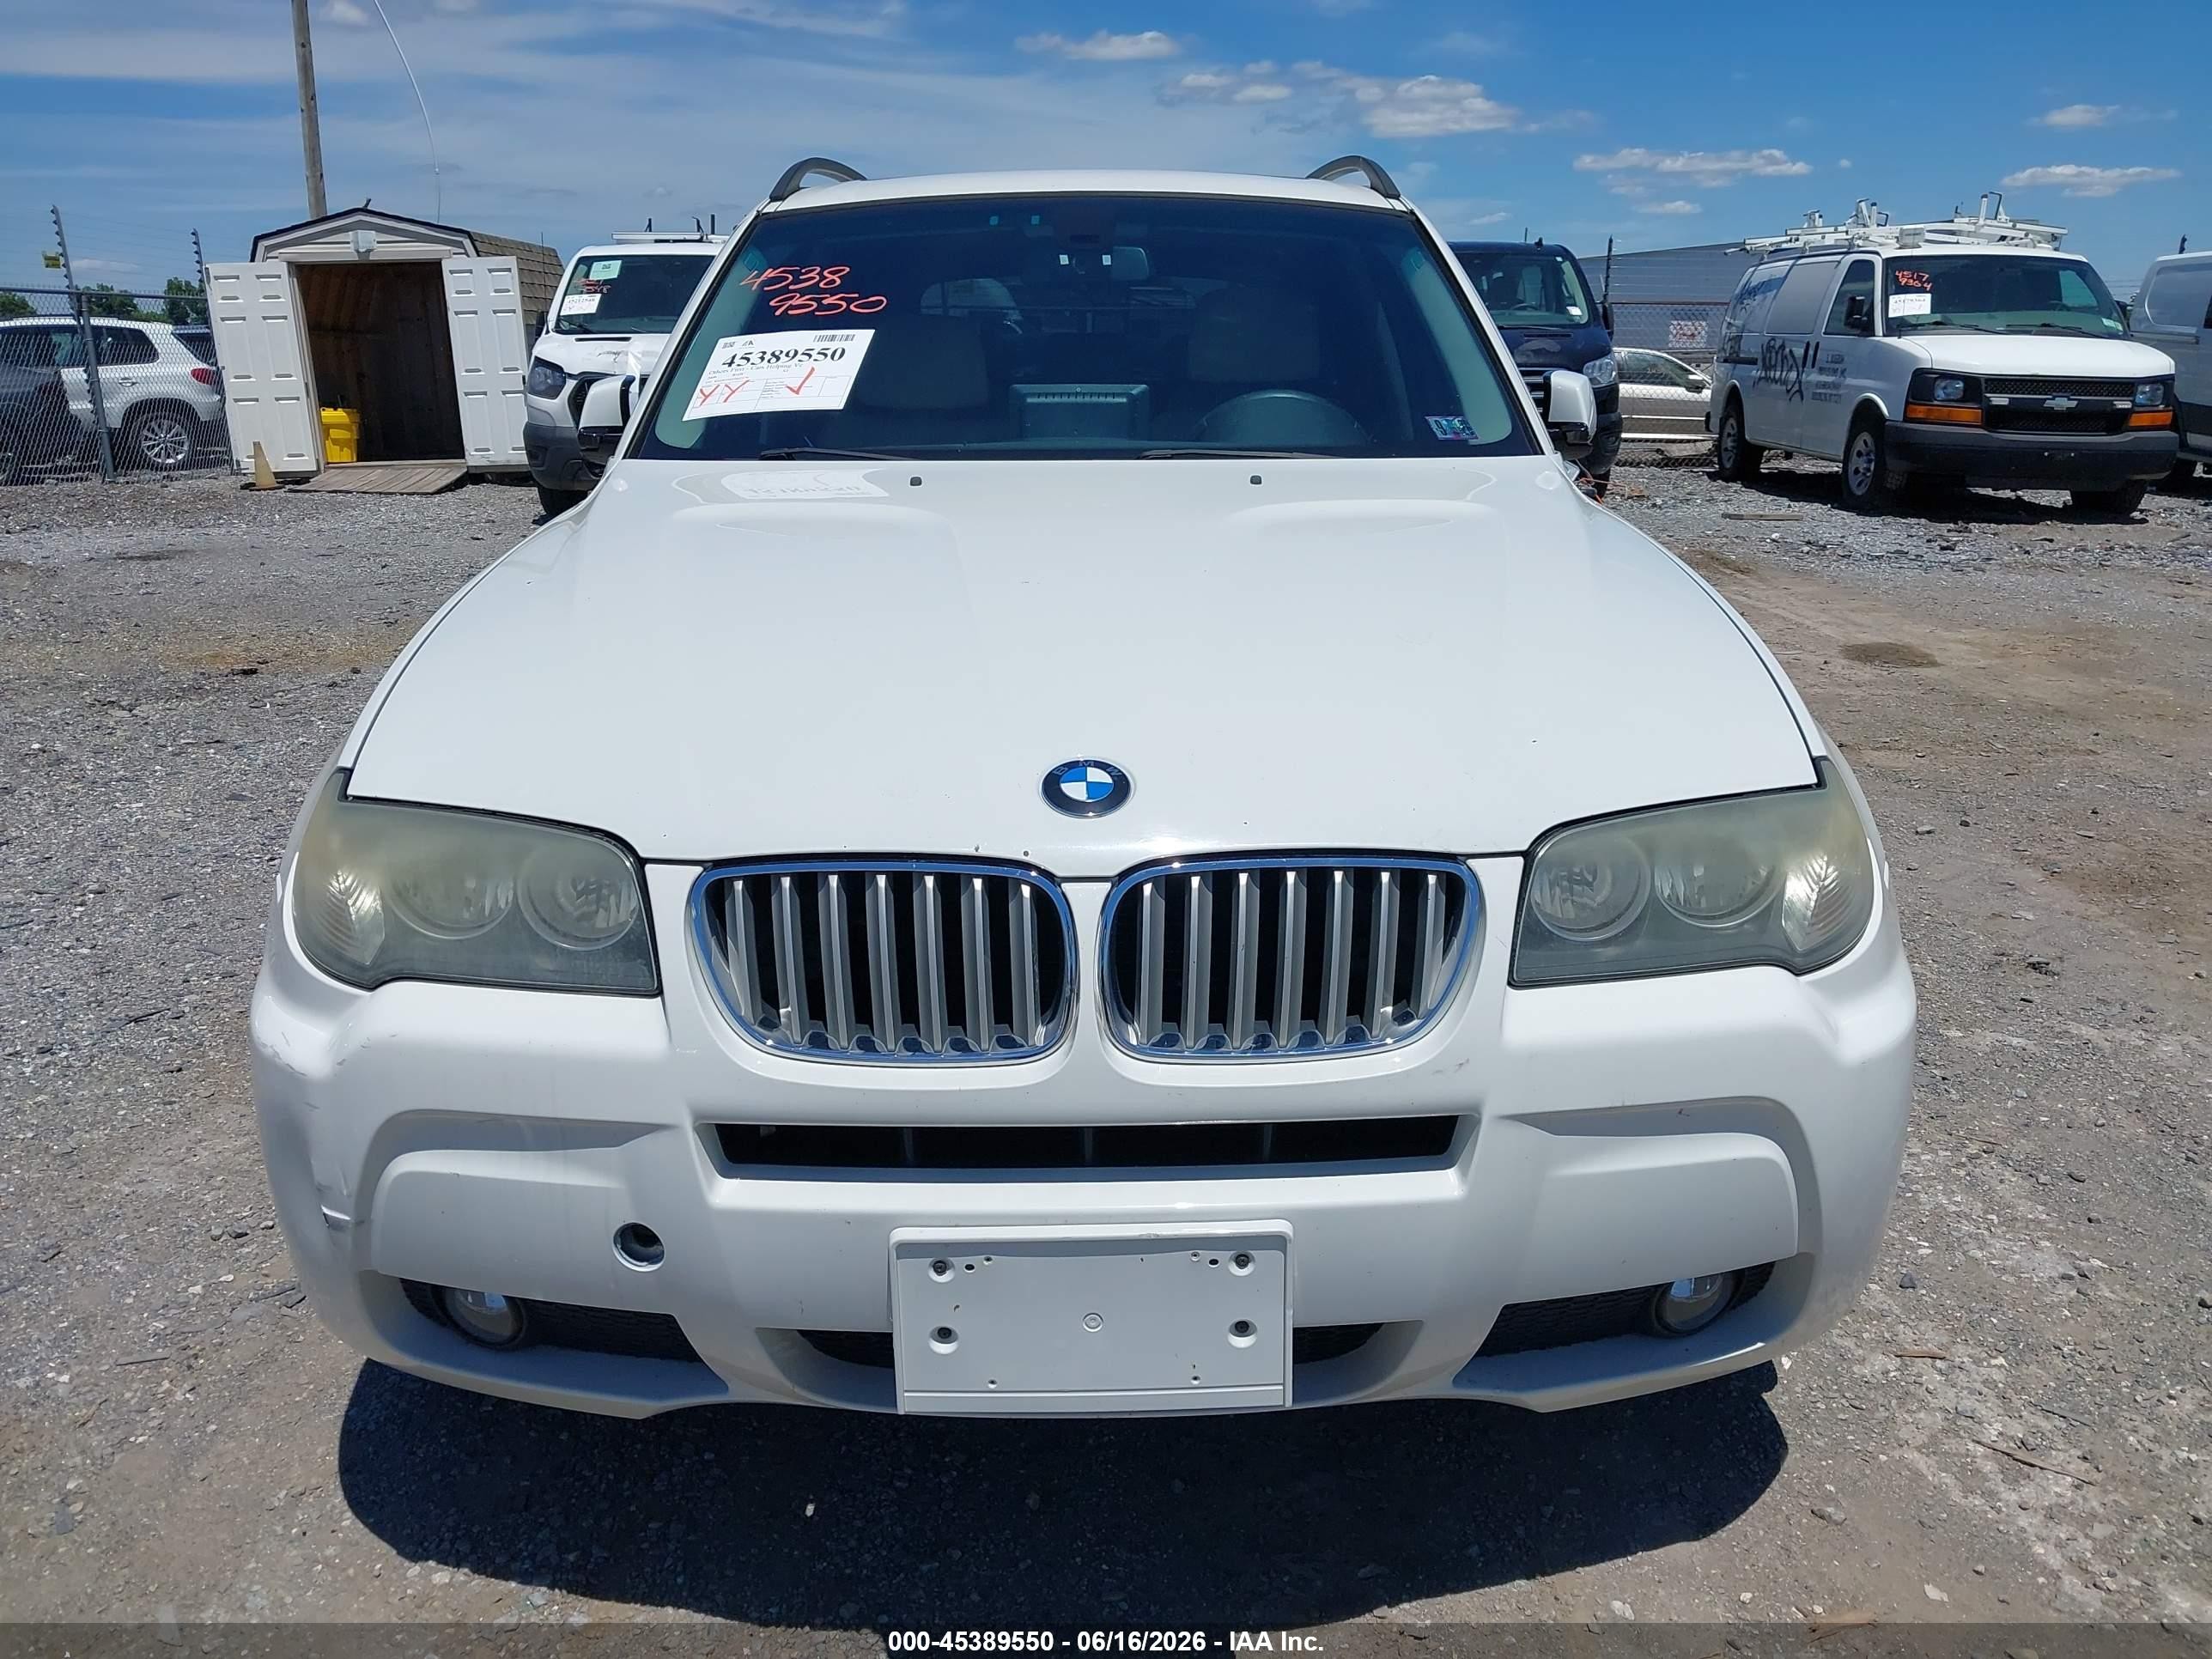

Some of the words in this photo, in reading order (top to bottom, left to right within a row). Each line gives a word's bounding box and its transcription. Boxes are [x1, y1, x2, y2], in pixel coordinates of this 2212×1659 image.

[739, 266, 850, 290] 4538
[1895, 270, 1930, 281] 4517
[769, 293, 888, 316] 9550
[721, 347, 846, 368] 45389550
[1052, 761, 1121, 775] BMW
